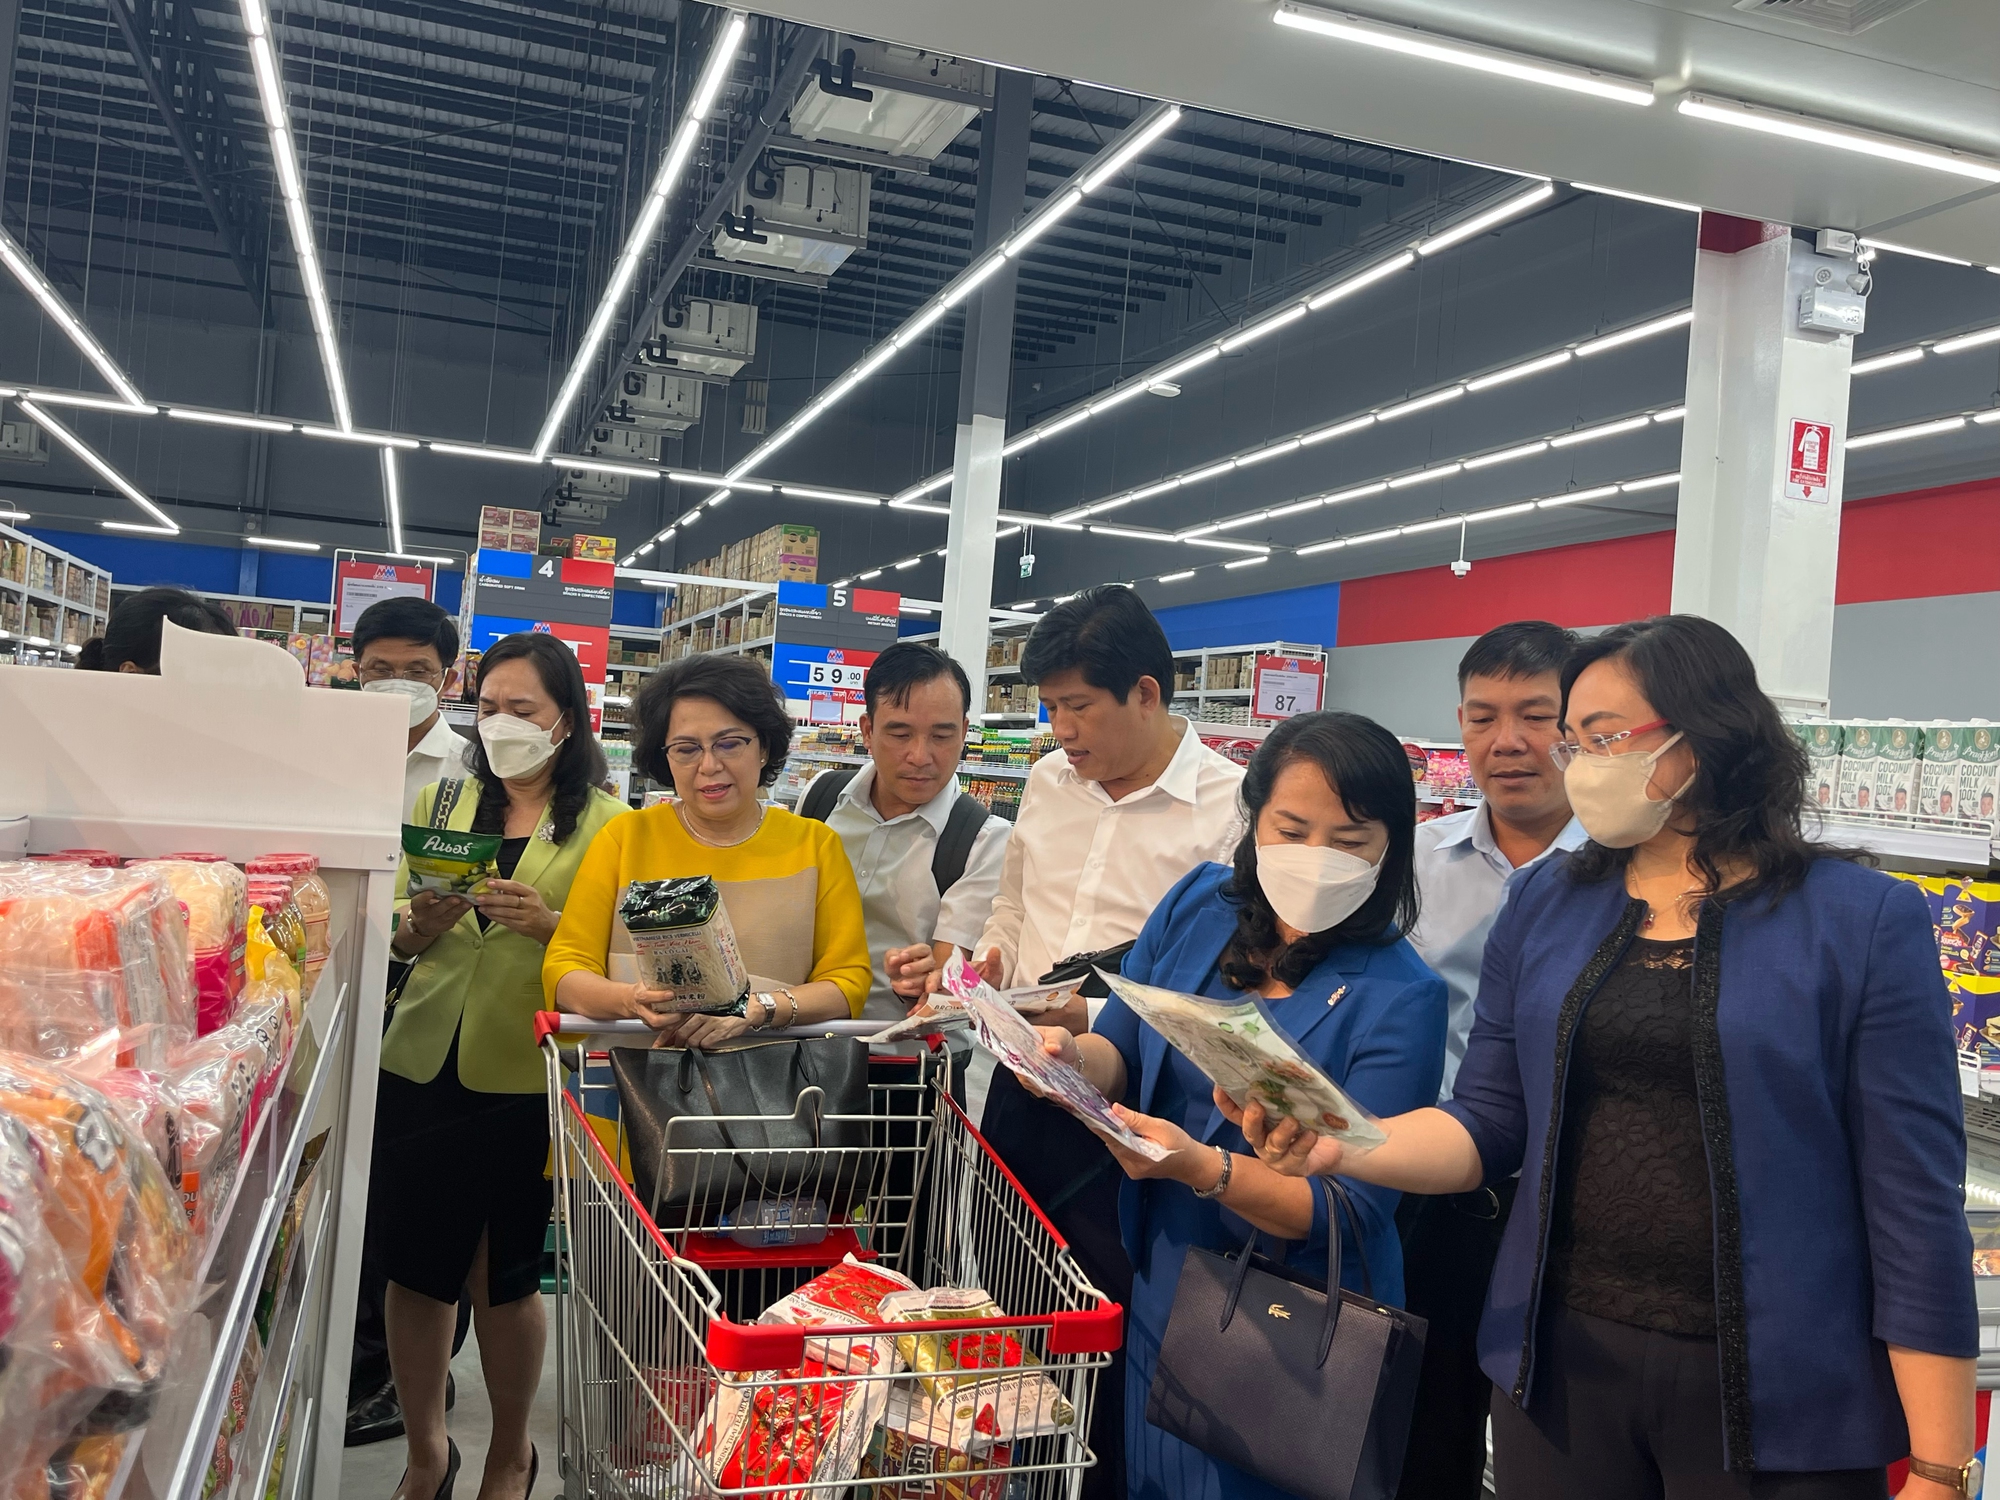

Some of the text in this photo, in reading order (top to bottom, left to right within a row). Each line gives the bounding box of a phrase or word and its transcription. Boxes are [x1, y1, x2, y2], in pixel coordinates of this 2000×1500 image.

[538, 559, 554, 578] 4
[832, 589, 847, 607] 5
[1275, 695, 1296, 712] 87
[1843, 760, 1874, 772] COCONUT
[1878, 761, 1912, 774] COCONUT
[1924, 763, 1957, 776] COCONUT
[1961, 764, 1998, 777] COCONUT
[1841, 771, 1857, 782] MILK
[1876, 772, 1894, 784] MILK
[1922, 775, 1939, 787] MILK
[1960, 776, 1979, 788] MILK
[714, 1398, 751, 1468] DRINK THAI TEA MIX
[818, 1450, 835, 1482] PRODUCT
[907, 1445, 933, 1490] PRETZ
